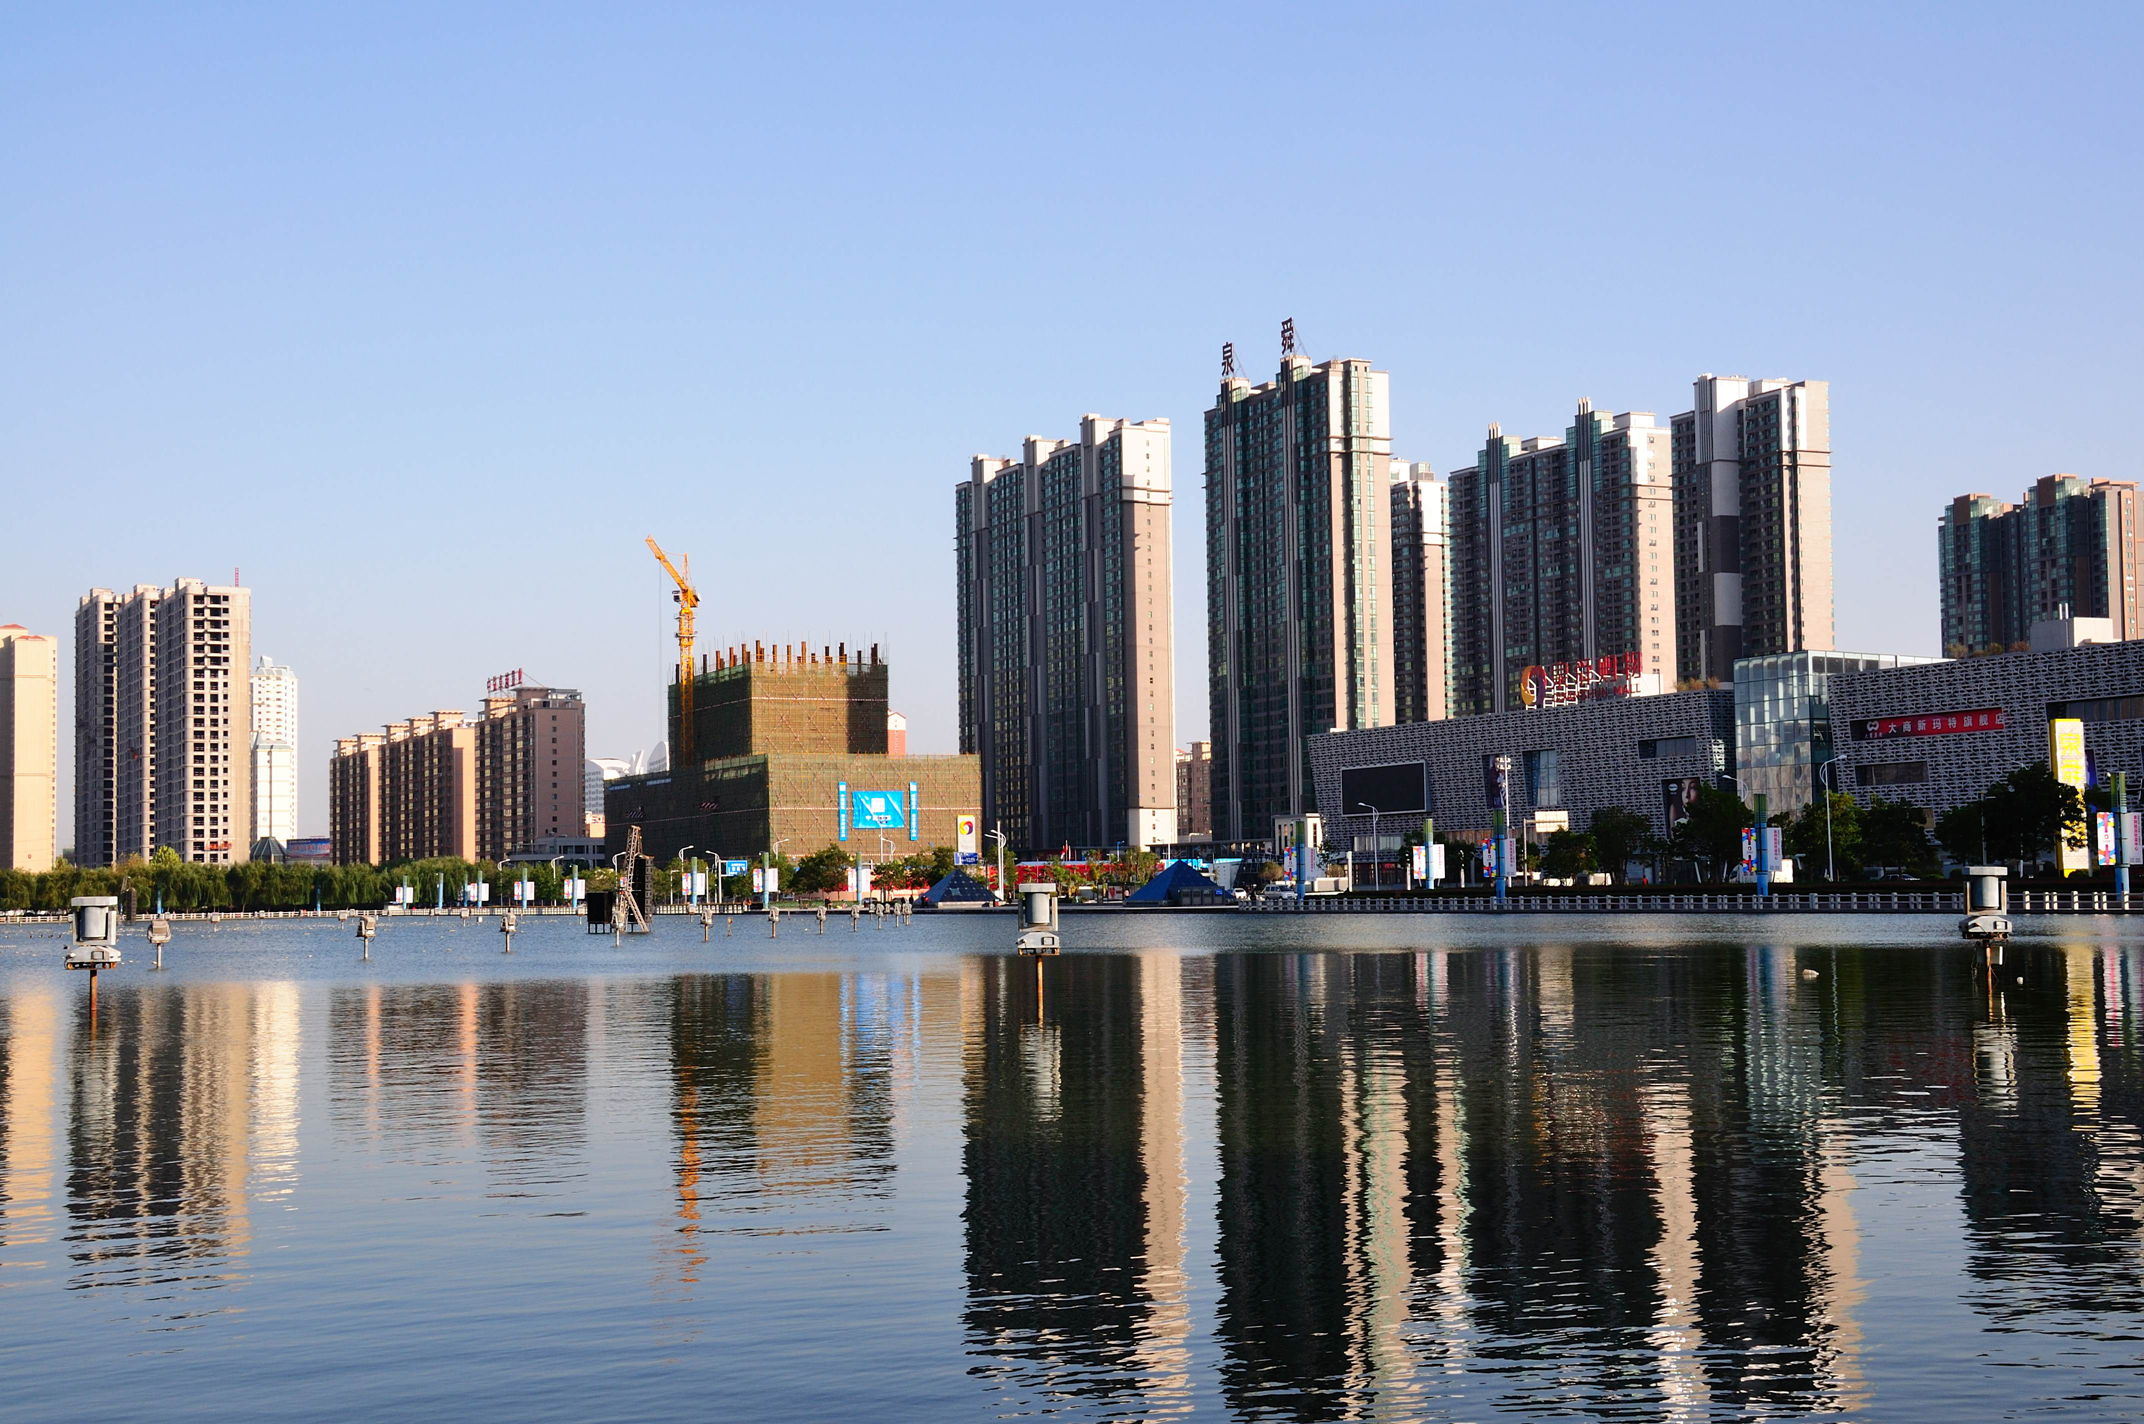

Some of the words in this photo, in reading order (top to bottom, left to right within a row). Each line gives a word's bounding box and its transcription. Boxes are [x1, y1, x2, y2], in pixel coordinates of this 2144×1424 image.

[1221, 342, 1234, 376] 泉
[1613, 683, 1641, 695] MALL
[1888, 712, 2005, 734] 大商新玛特旗舰店
